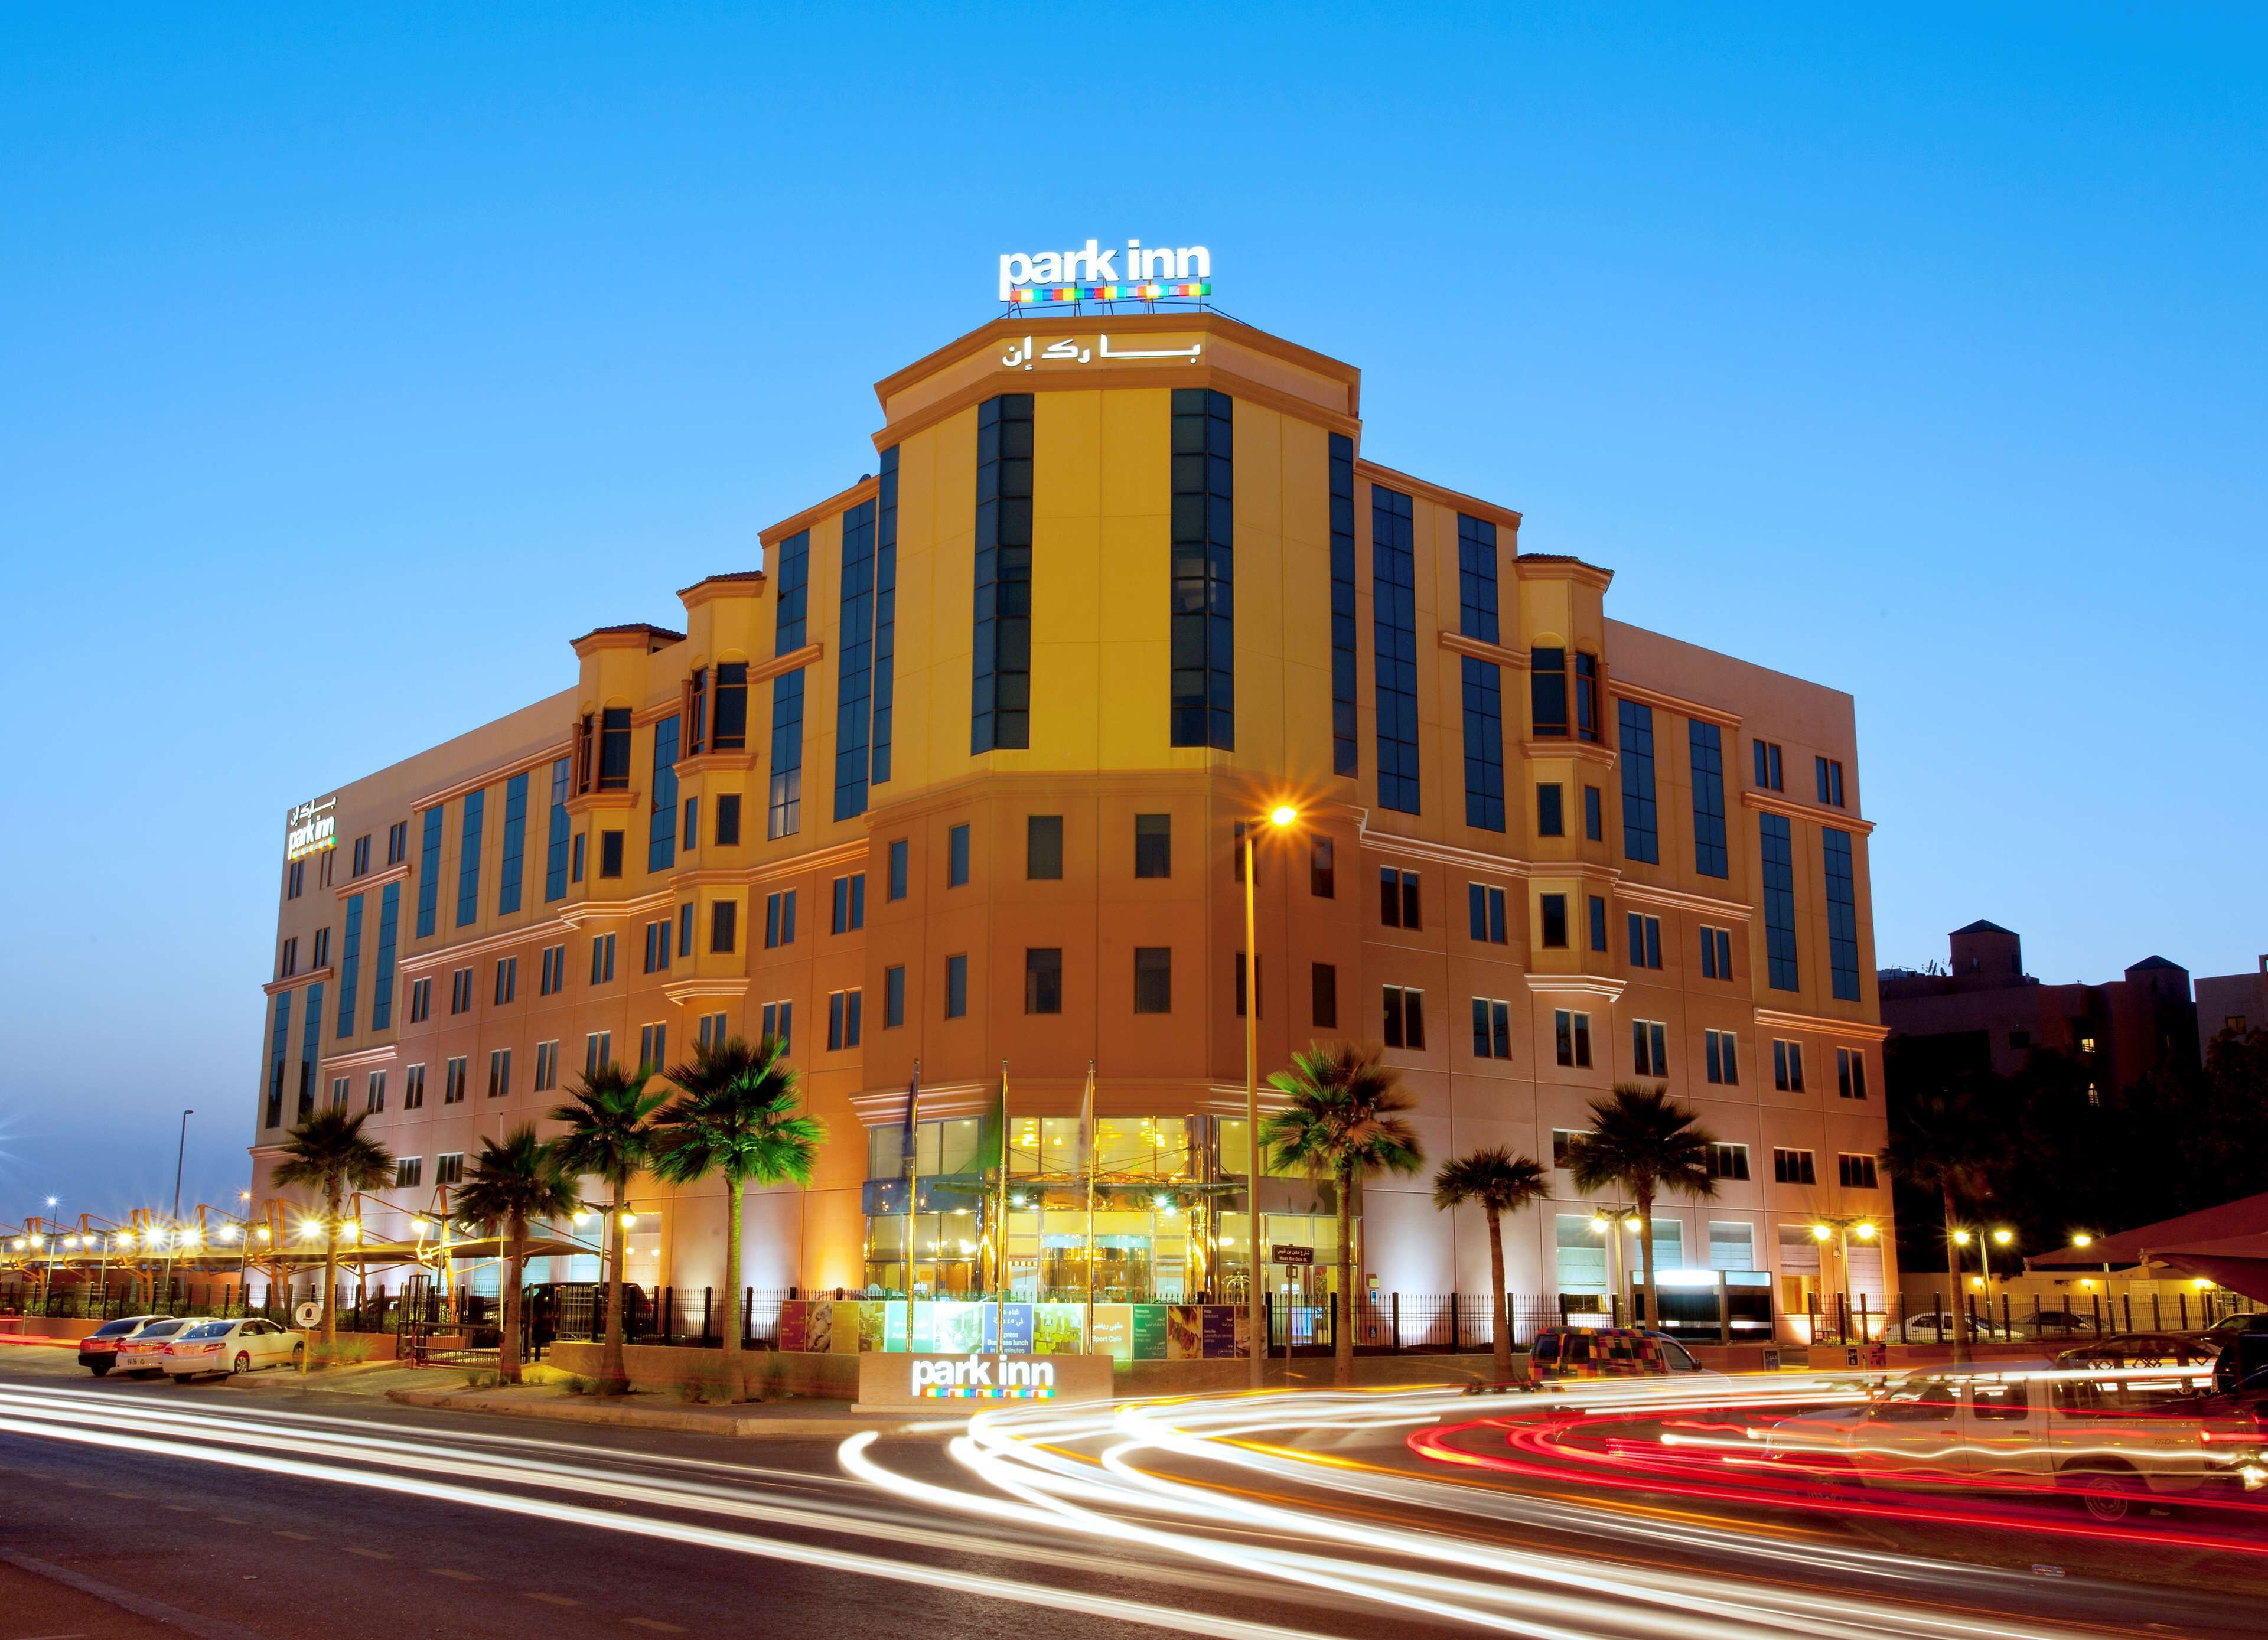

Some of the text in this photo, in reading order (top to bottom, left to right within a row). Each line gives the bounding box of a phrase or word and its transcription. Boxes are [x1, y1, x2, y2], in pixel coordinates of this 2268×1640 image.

[999, 239, 1210, 302] park inn
[288, 815, 335, 860] park inn
[912, 1354, 1054, 1396] park inn
